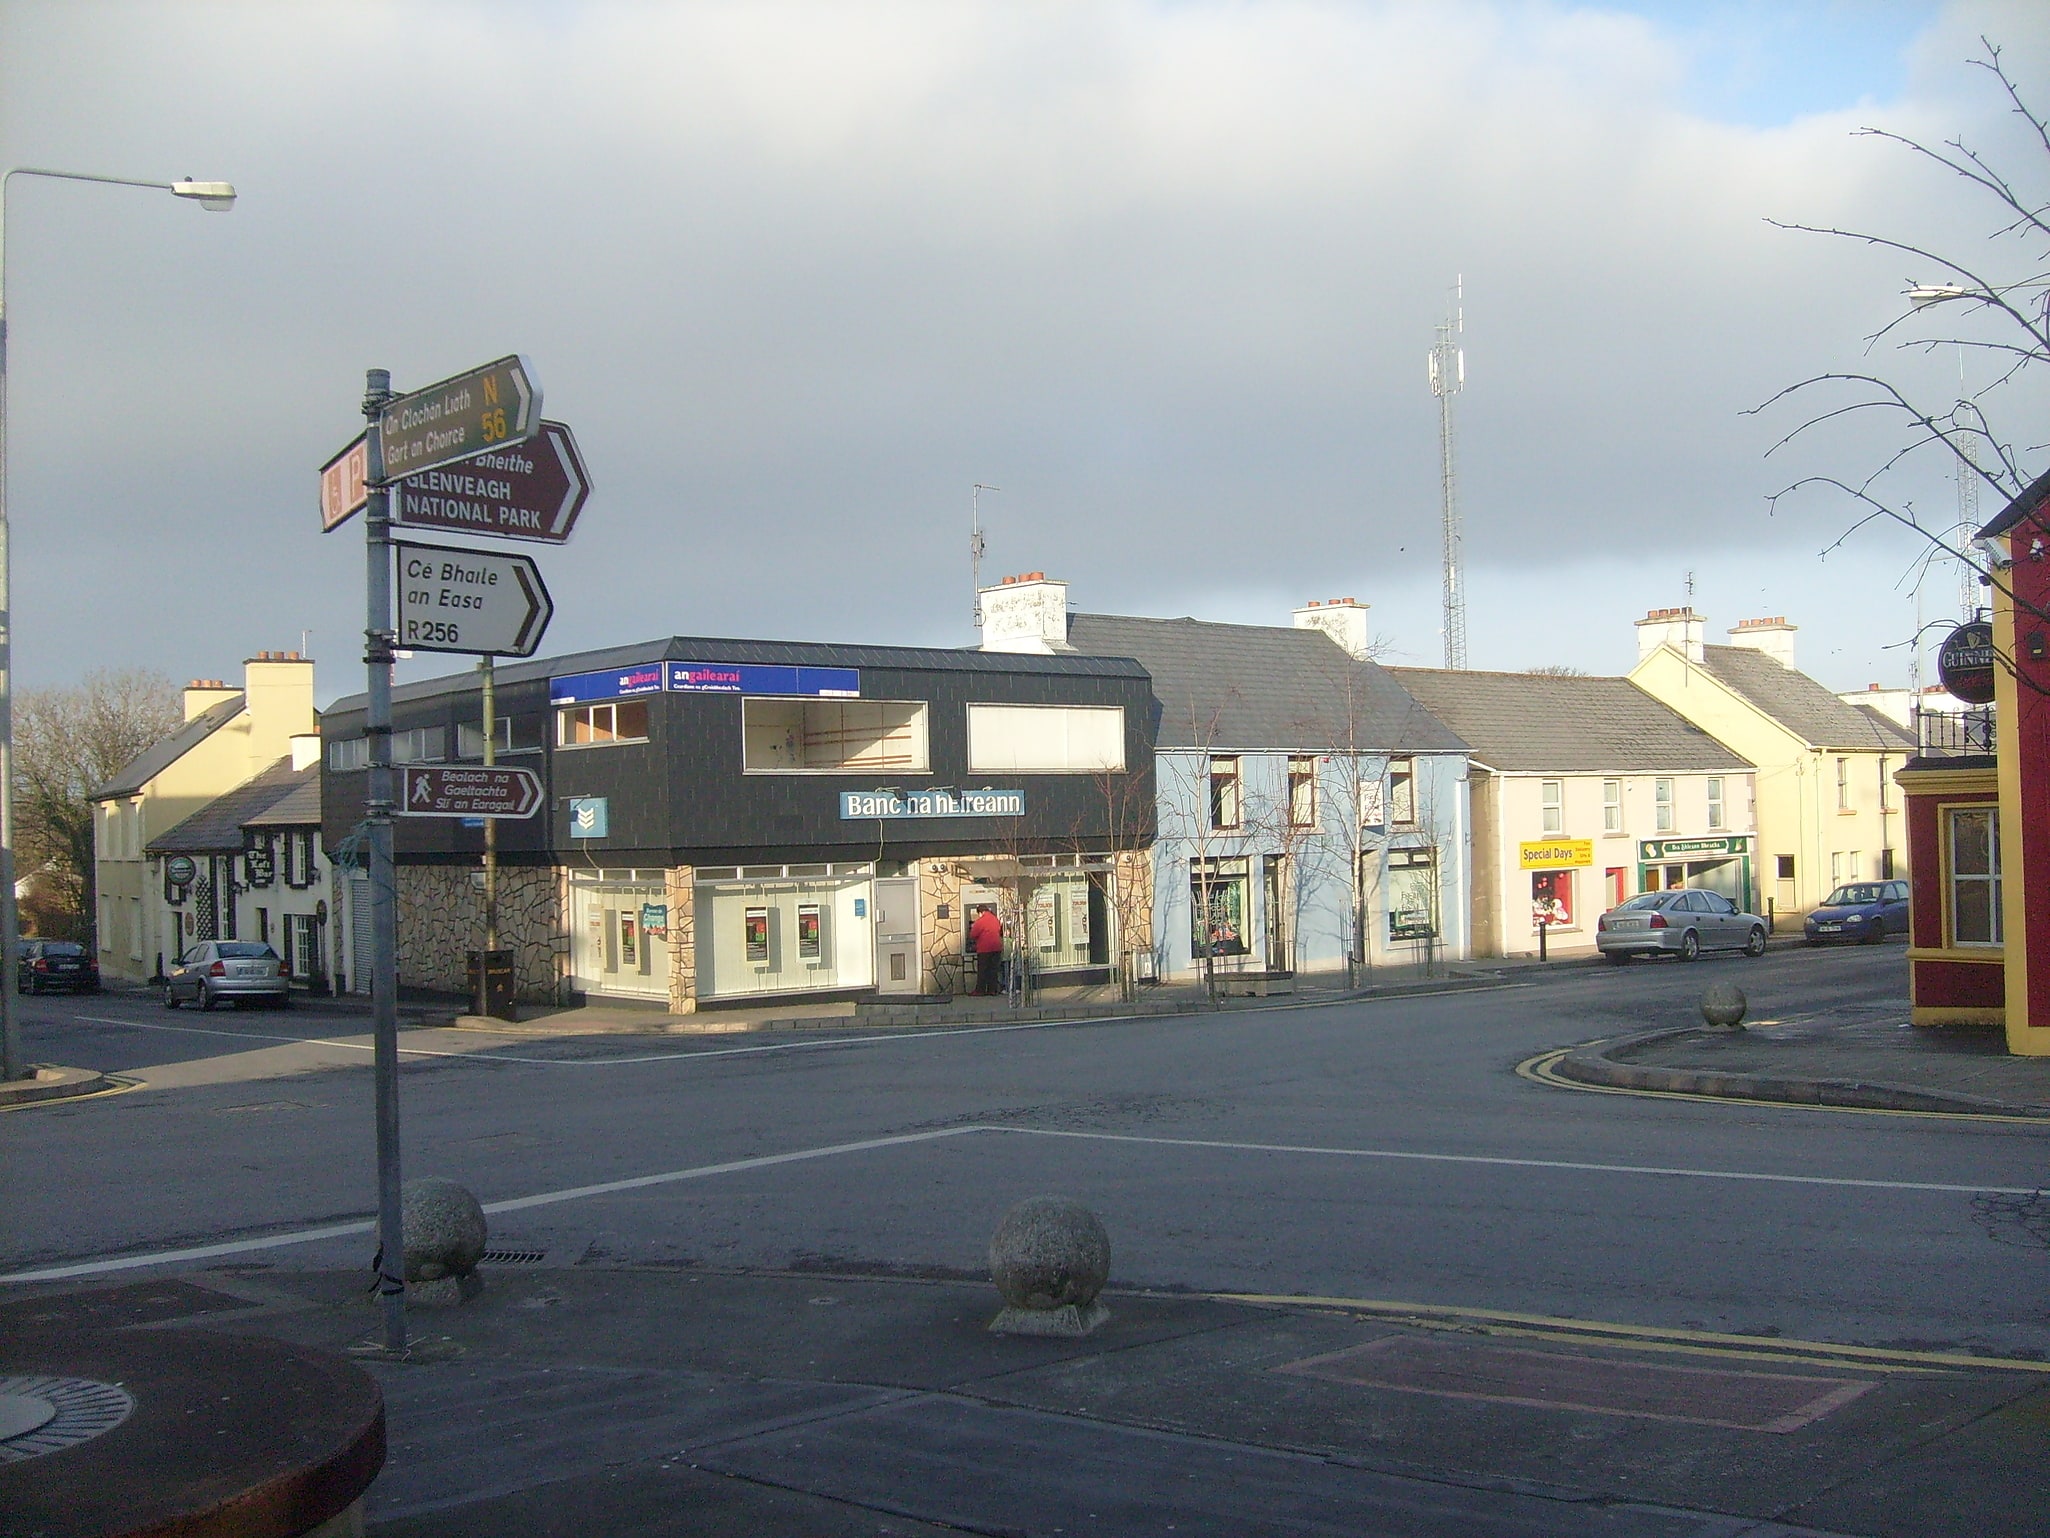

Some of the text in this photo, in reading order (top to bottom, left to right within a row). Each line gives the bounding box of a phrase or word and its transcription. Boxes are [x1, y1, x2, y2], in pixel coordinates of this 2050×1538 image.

[484, 375, 498, 406] N
[402, 398, 441, 430] Clochán
[444, 388, 471, 415] Liath
[482, 408, 507, 442] 56
[388, 426, 465, 465] Gort an Choirce
[406, 471, 511, 501] GLENVEAGH
[406, 494, 542, 530] NATIONAL PARK
[407, 560, 498, 586] Cé Bhaile
[408, 588, 483, 610] an Easa
[407, 619, 459, 644] R256
[1943, 649, 1994, 668] GUINNE
[441, 770, 510, 784] Bealach na
[444, 784, 507, 797] Gaeltachta
[435, 797, 516, 812] Slí an Earagail
[847, 795, 901, 816] Banc
[907, 796, 931, 814] na
[248, 850, 267, 860] The
[1523, 847, 1573, 863] Special Days
